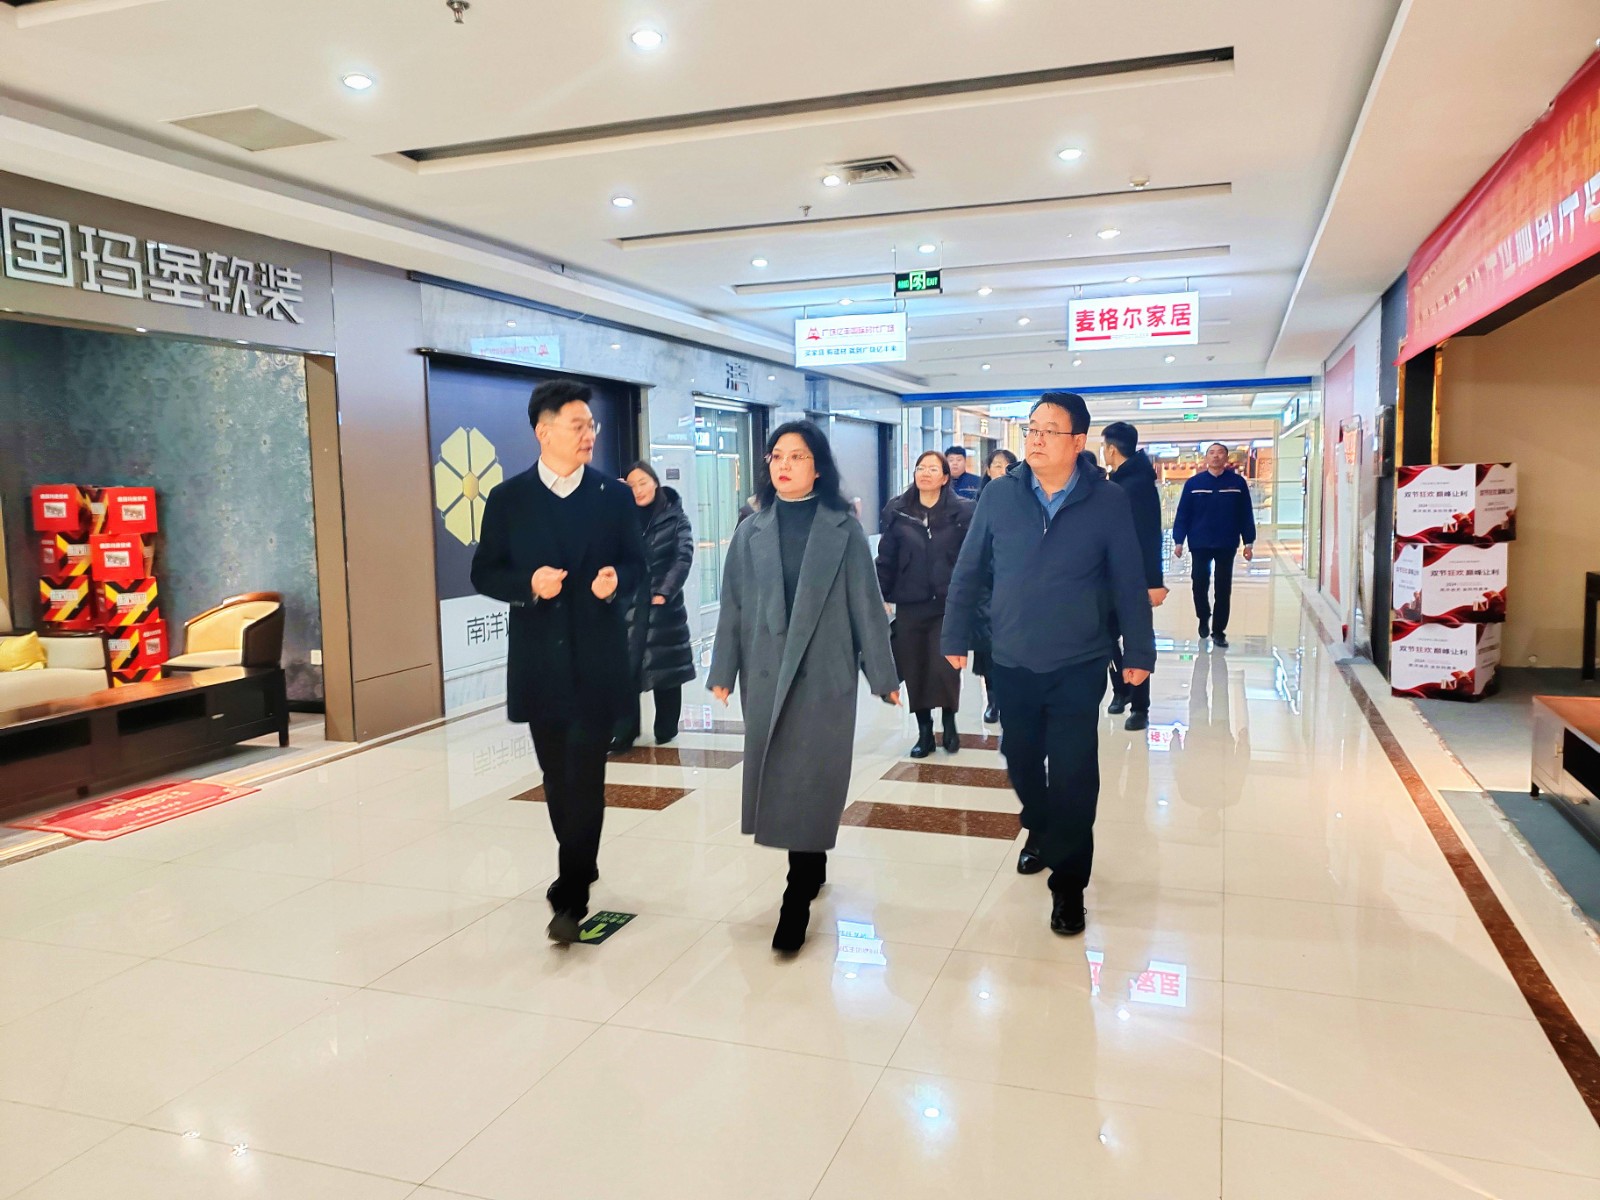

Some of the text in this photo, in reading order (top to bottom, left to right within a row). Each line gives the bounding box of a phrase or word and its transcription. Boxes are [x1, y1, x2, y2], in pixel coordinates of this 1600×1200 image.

[1, 207, 304, 324] 国玛堡软装
[1076, 303, 1192, 332] 麦格尔家居
